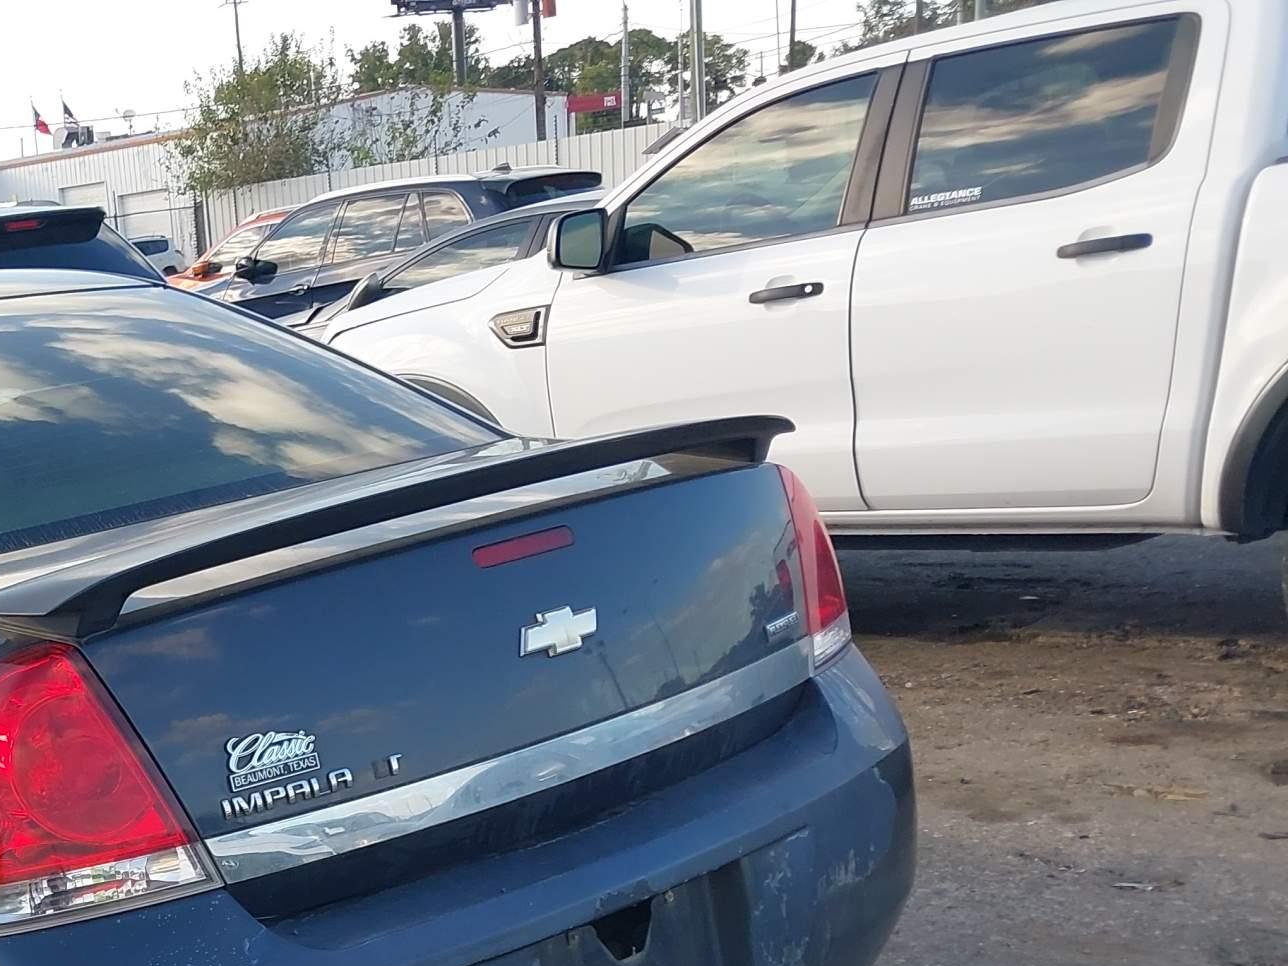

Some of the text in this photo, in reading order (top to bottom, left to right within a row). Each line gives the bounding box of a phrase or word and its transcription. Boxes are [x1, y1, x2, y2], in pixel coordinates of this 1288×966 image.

[910, 187, 982, 206] ALLEGIANCE
[226, 730, 316, 774] Classic
[233, 757, 317, 788] BEAUMONT, TEXAS
[222, 768, 353, 819] IMPALA
